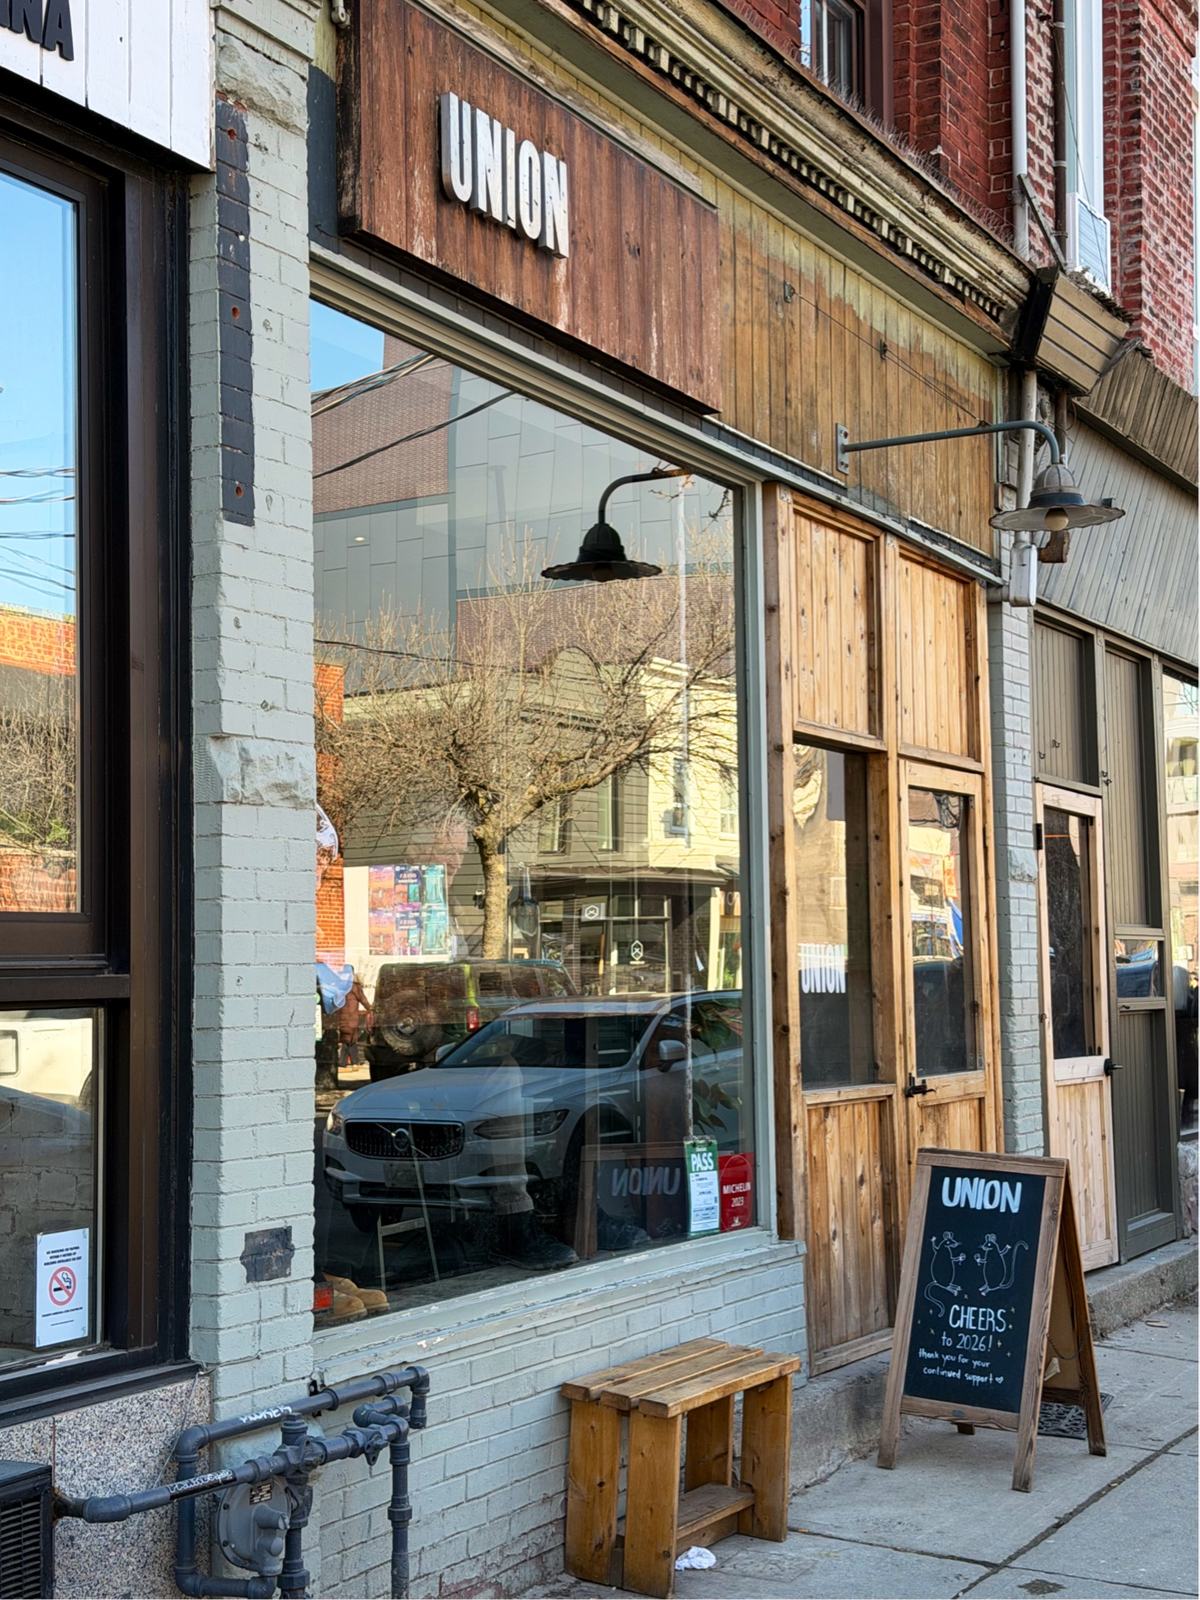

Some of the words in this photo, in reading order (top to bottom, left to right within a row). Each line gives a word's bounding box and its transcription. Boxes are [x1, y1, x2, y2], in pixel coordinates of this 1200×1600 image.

[0, 0, 74, 61] NA
[441, 91, 569, 258] UNION
[801, 943, 846, 994] UNION
[690, 1152, 714, 1172] PASS
[722, 1182, 751, 1195] MICHELIN
[941, 1176, 1023, 1214] UNION
[949, 1304, 1006, 1333] CHEERS
[941, 1331, 953, 1347] to
[955, 1333, 993, 1352] 2026!
[941, 1354, 956, 1367] you
[958, 1354, 969, 1363] for
[971, 1360, 991, 1369] your
[923, 1366, 961, 1379] continued
[964, 1373, 993, 1386] support
